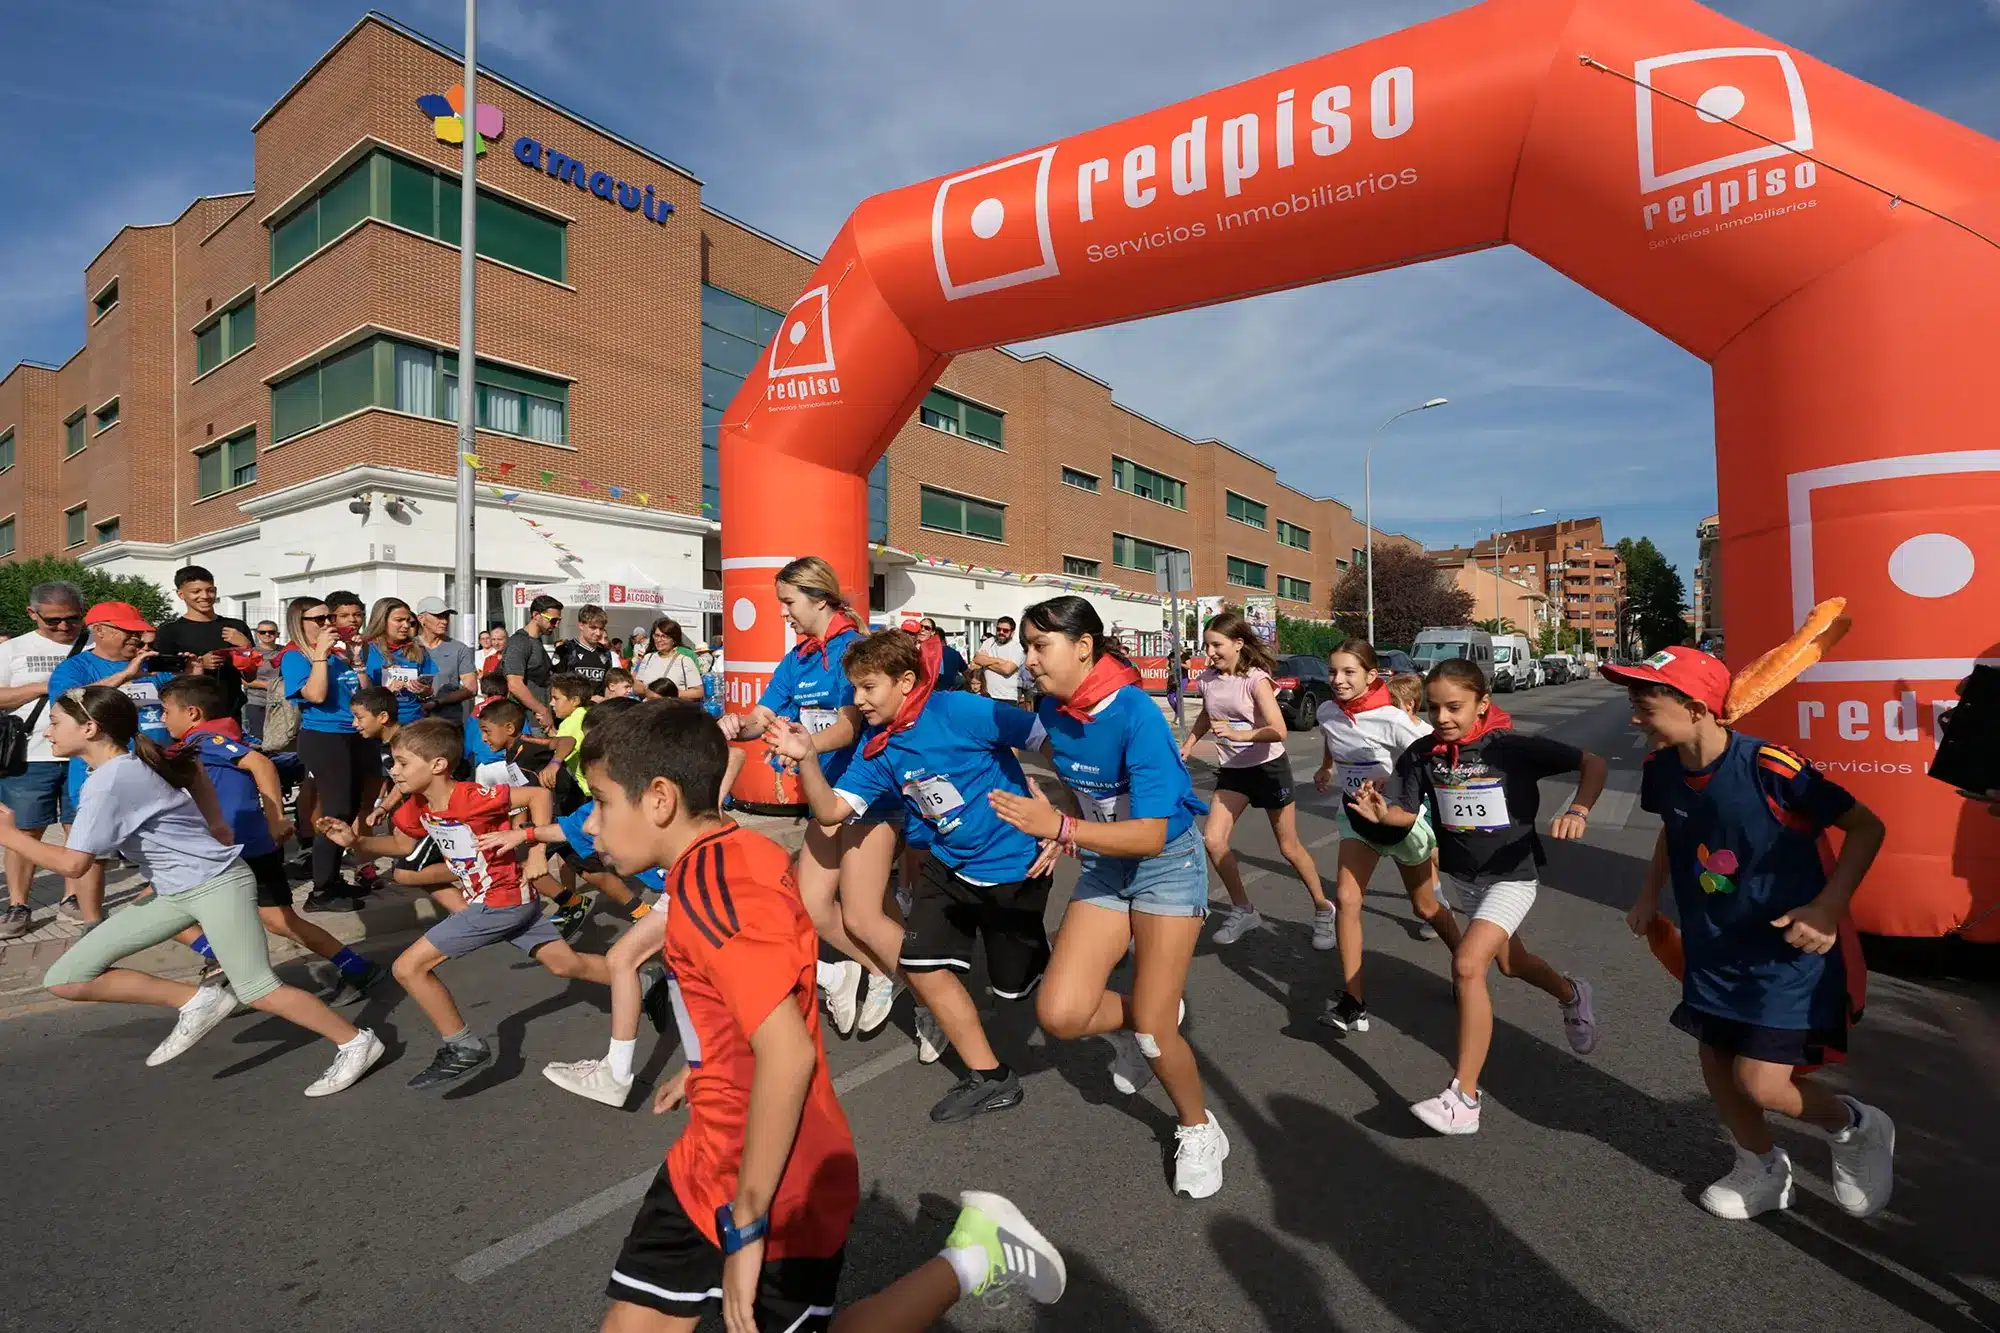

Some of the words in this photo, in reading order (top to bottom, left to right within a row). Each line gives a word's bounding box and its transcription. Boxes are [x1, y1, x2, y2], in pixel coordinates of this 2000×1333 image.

[1077, 66, 1414, 223] redpiso
[513, 136, 676, 224] amavir
[1643, 161, 1816, 231] redpiso
[1087, 221, 1207, 263] Servicios
[1216, 167, 1419, 232] Inmobiliarios
[1648, 226, 1711, 250] Servicios
[1715, 199, 1818, 232] Inmobiliarios
[767, 376, 841, 401] redpiso
[627, 591, 664, 603] ALCORCÓN
[920, 793, 943, 807] 115
[1454, 804, 1487, 817] 213
[436, 838, 455, 850] 127
